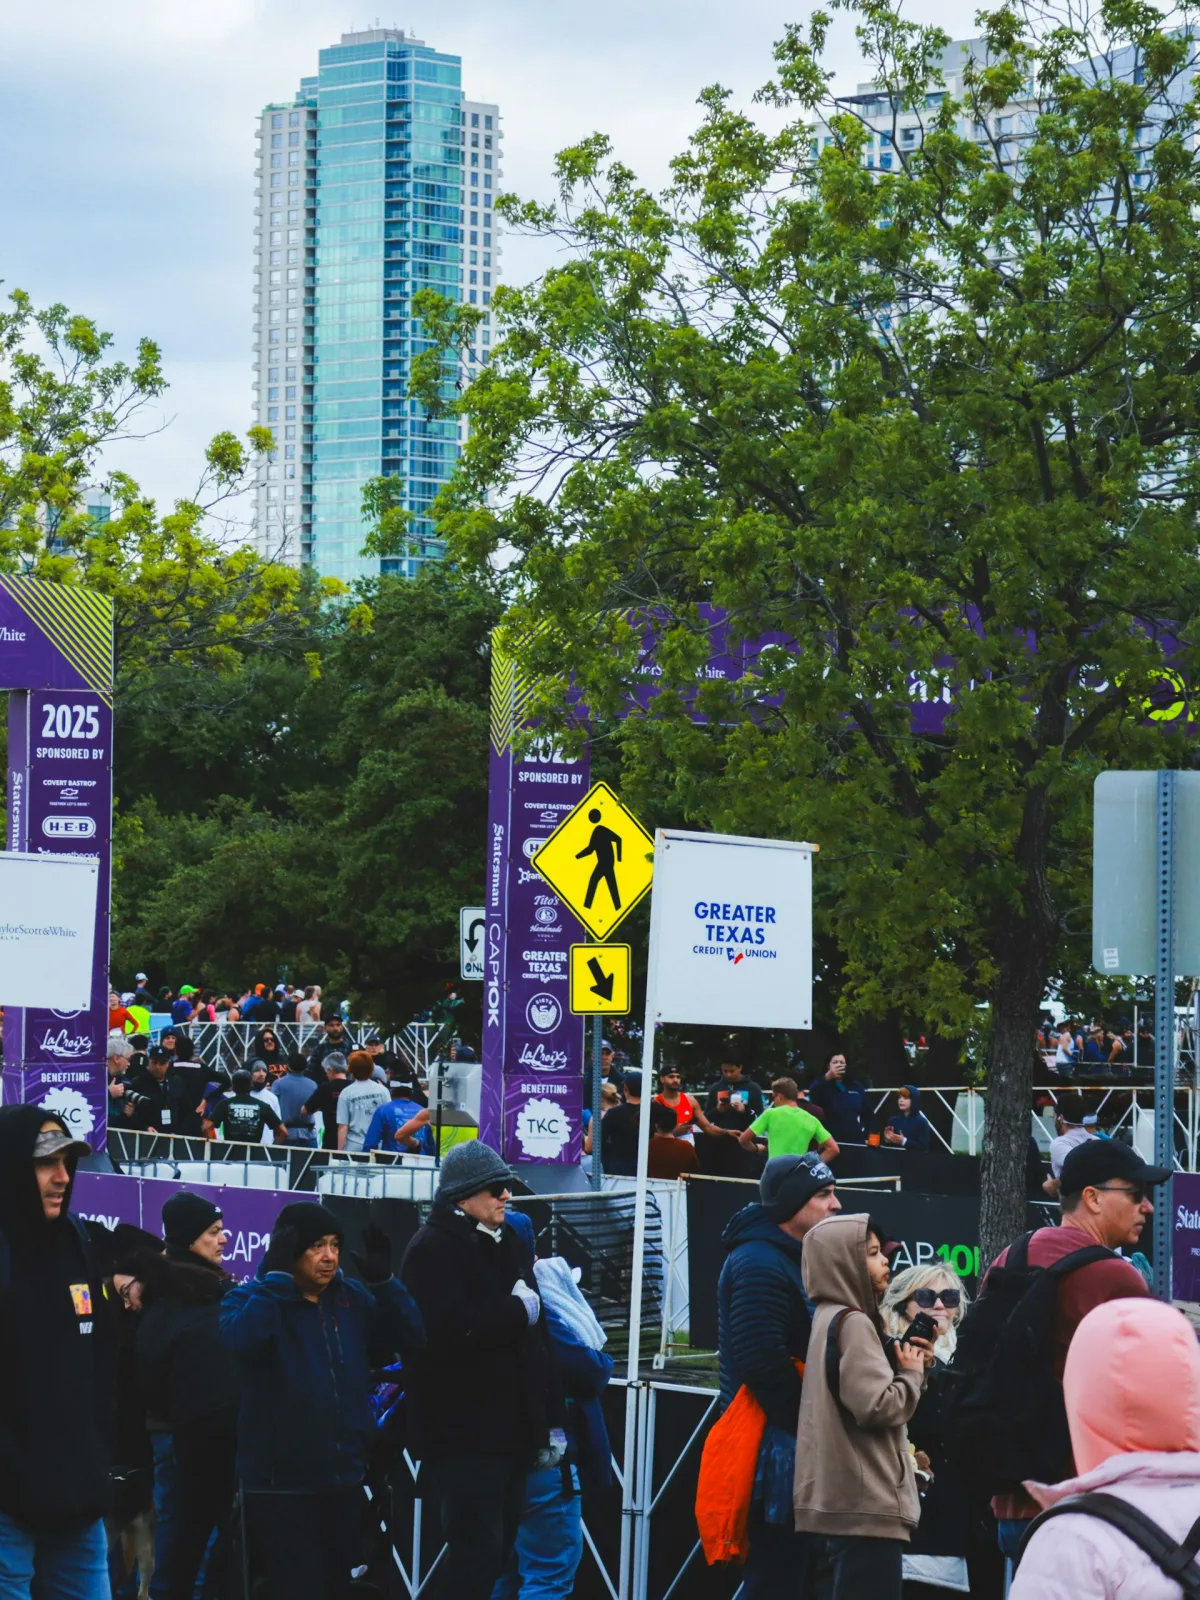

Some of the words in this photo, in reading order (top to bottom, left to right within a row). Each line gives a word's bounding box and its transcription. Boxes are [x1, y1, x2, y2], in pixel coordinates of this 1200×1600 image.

[41, 703, 100, 740] 2025
[36, 747, 90, 760] SPONSORED
[92, 749, 104, 760] BY
[518, 771, 569, 784] SPONSORED
[571, 774, 583, 785] BY
[491, 822, 505, 907] Statesman
[533, 894, 560, 906] Tito's
[694, 901, 777, 924] GREATER
[705, 924, 766, 945] TEXAS
[522, 950, 568, 962] GREATER
[692, 945, 724, 955] CREDIT
[745, 948, 777, 959] UNION
[465, 962, 484, 973] ONL
[528, 962, 562, 973] TEXAS
[487, 922, 501, 1028] CAP10K
[41, 1072, 90, 1083] BENEFITING
[521, 1083, 568, 1095] BENEFITING
[233, 1108, 255, 1119] 2016
[526, 1117, 559, 1134] TKC
[220, 1228, 271, 1262] CAP1
[891, 1240, 980, 1278] AP10
